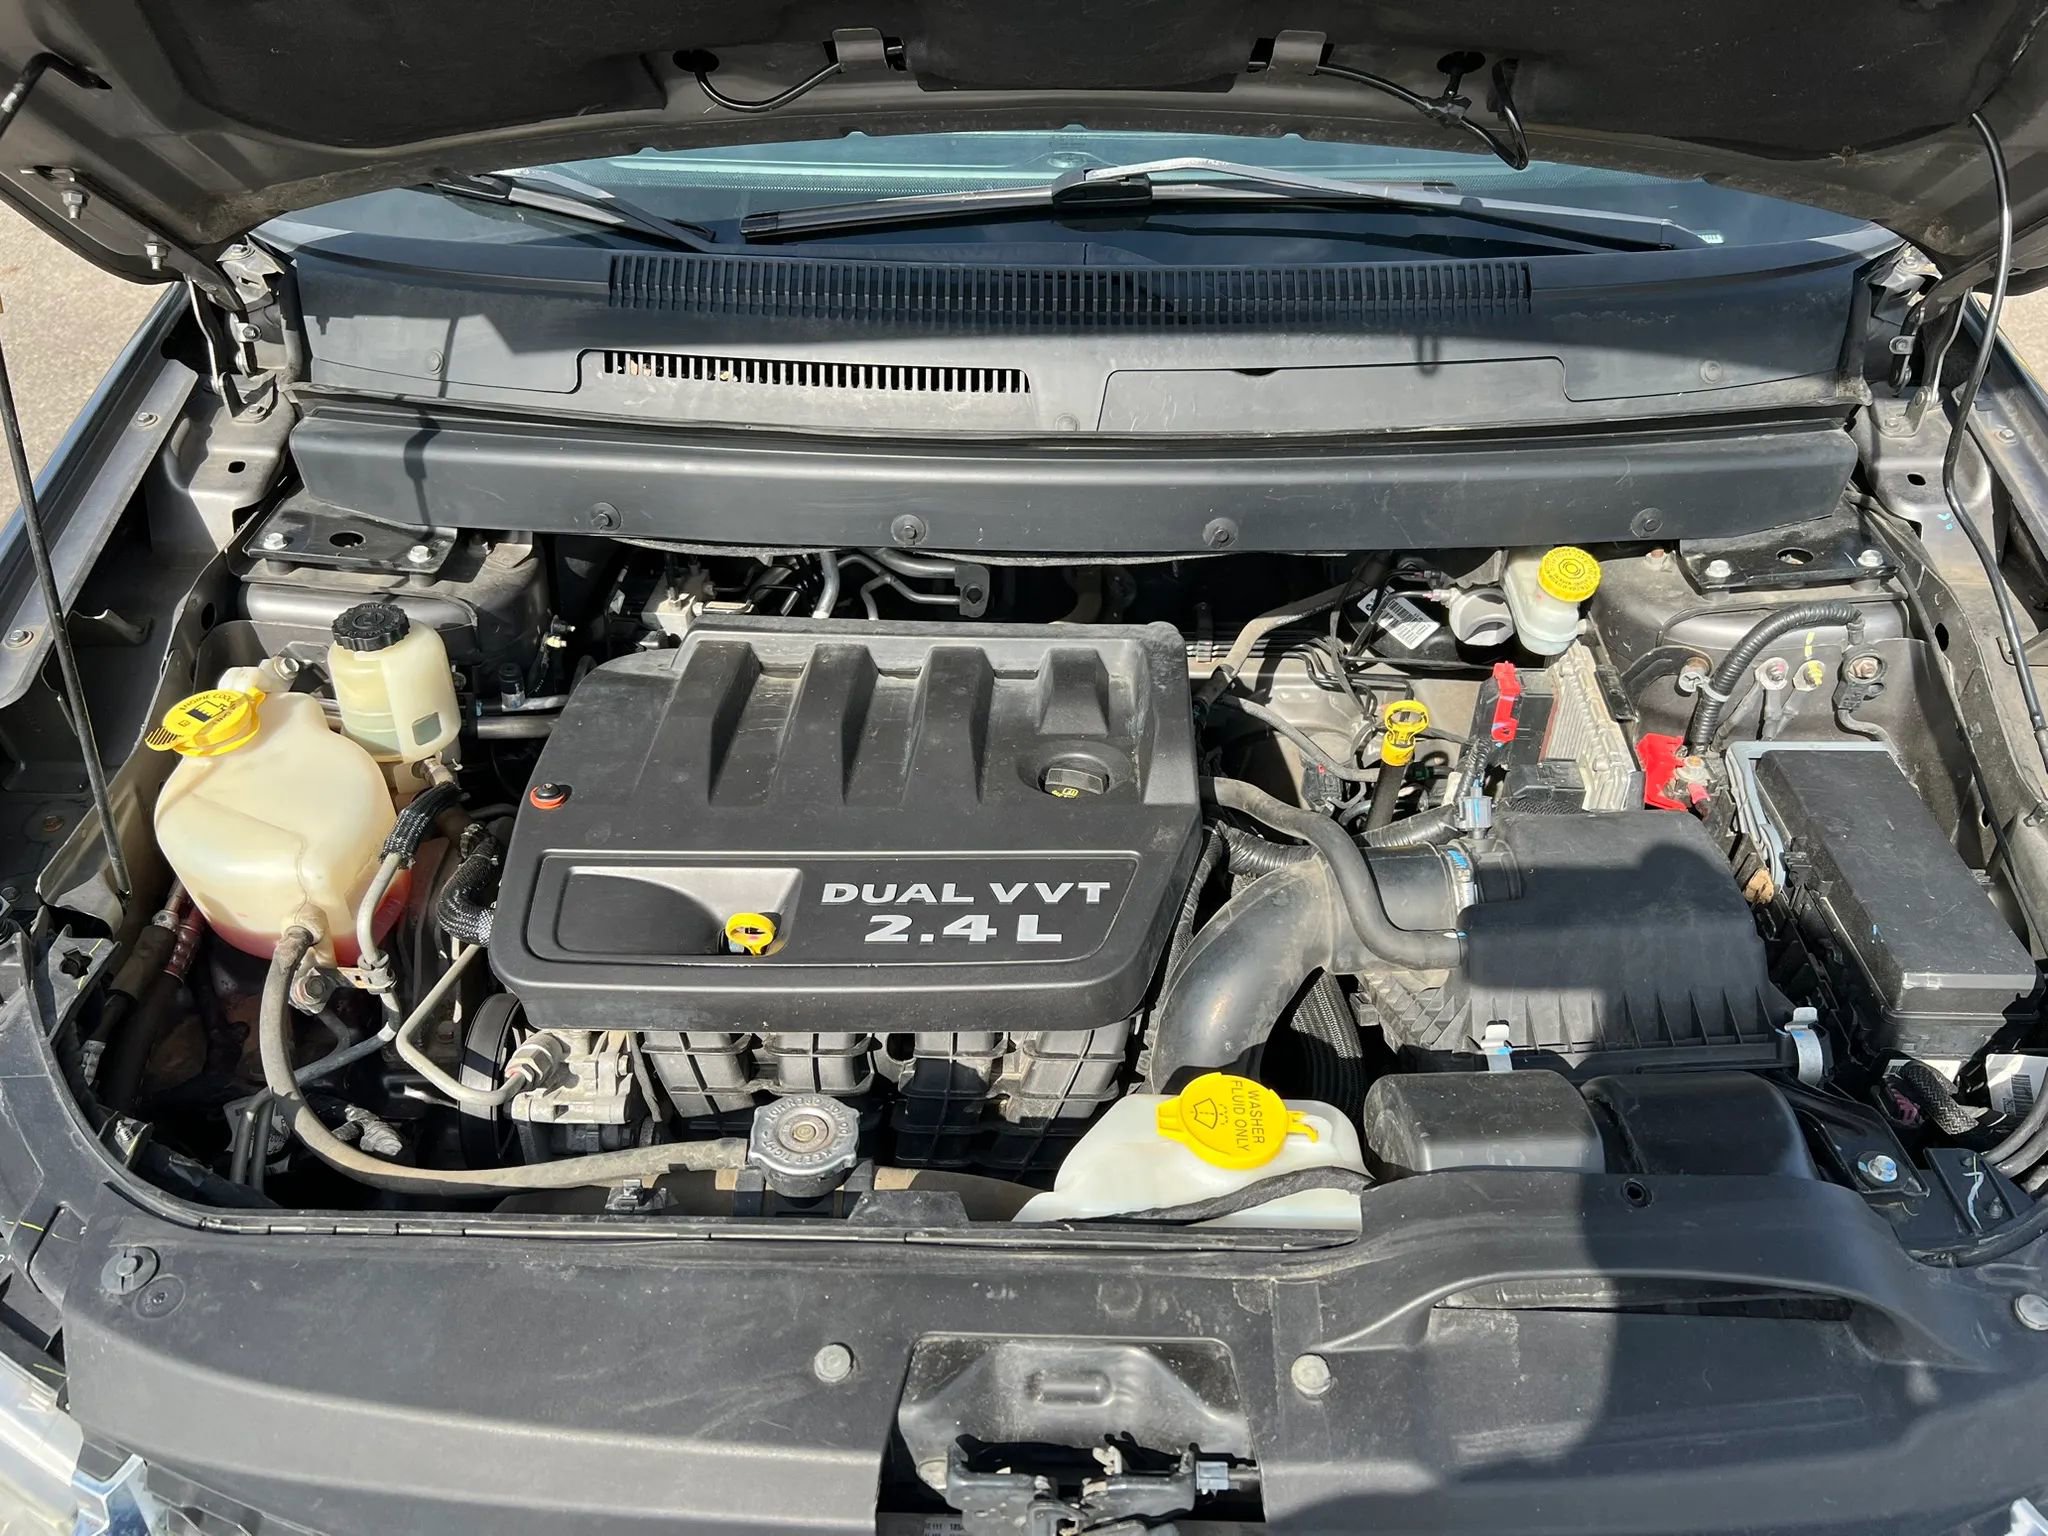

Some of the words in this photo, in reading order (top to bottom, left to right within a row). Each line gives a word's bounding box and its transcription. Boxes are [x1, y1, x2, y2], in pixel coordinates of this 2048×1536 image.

[820, 882, 975, 905] DUAL
[988, 881, 1111, 905] VVT
[863, 914, 998, 944] 2.4
[1016, 914, 1063, 944] L
[788, 1096, 821, 1107] OPEN
[1231, 1080, 1246, 1116] FLUID
[764, 1104, 787, 1123] HOT
[1248, 1089, 1265, 1144] WASHER
[1234, 1119, 1250, 1151] ONLY
[761, 1141, 791, 1163] TIGHT
[795, 1151, 832, 1164] KEEP
